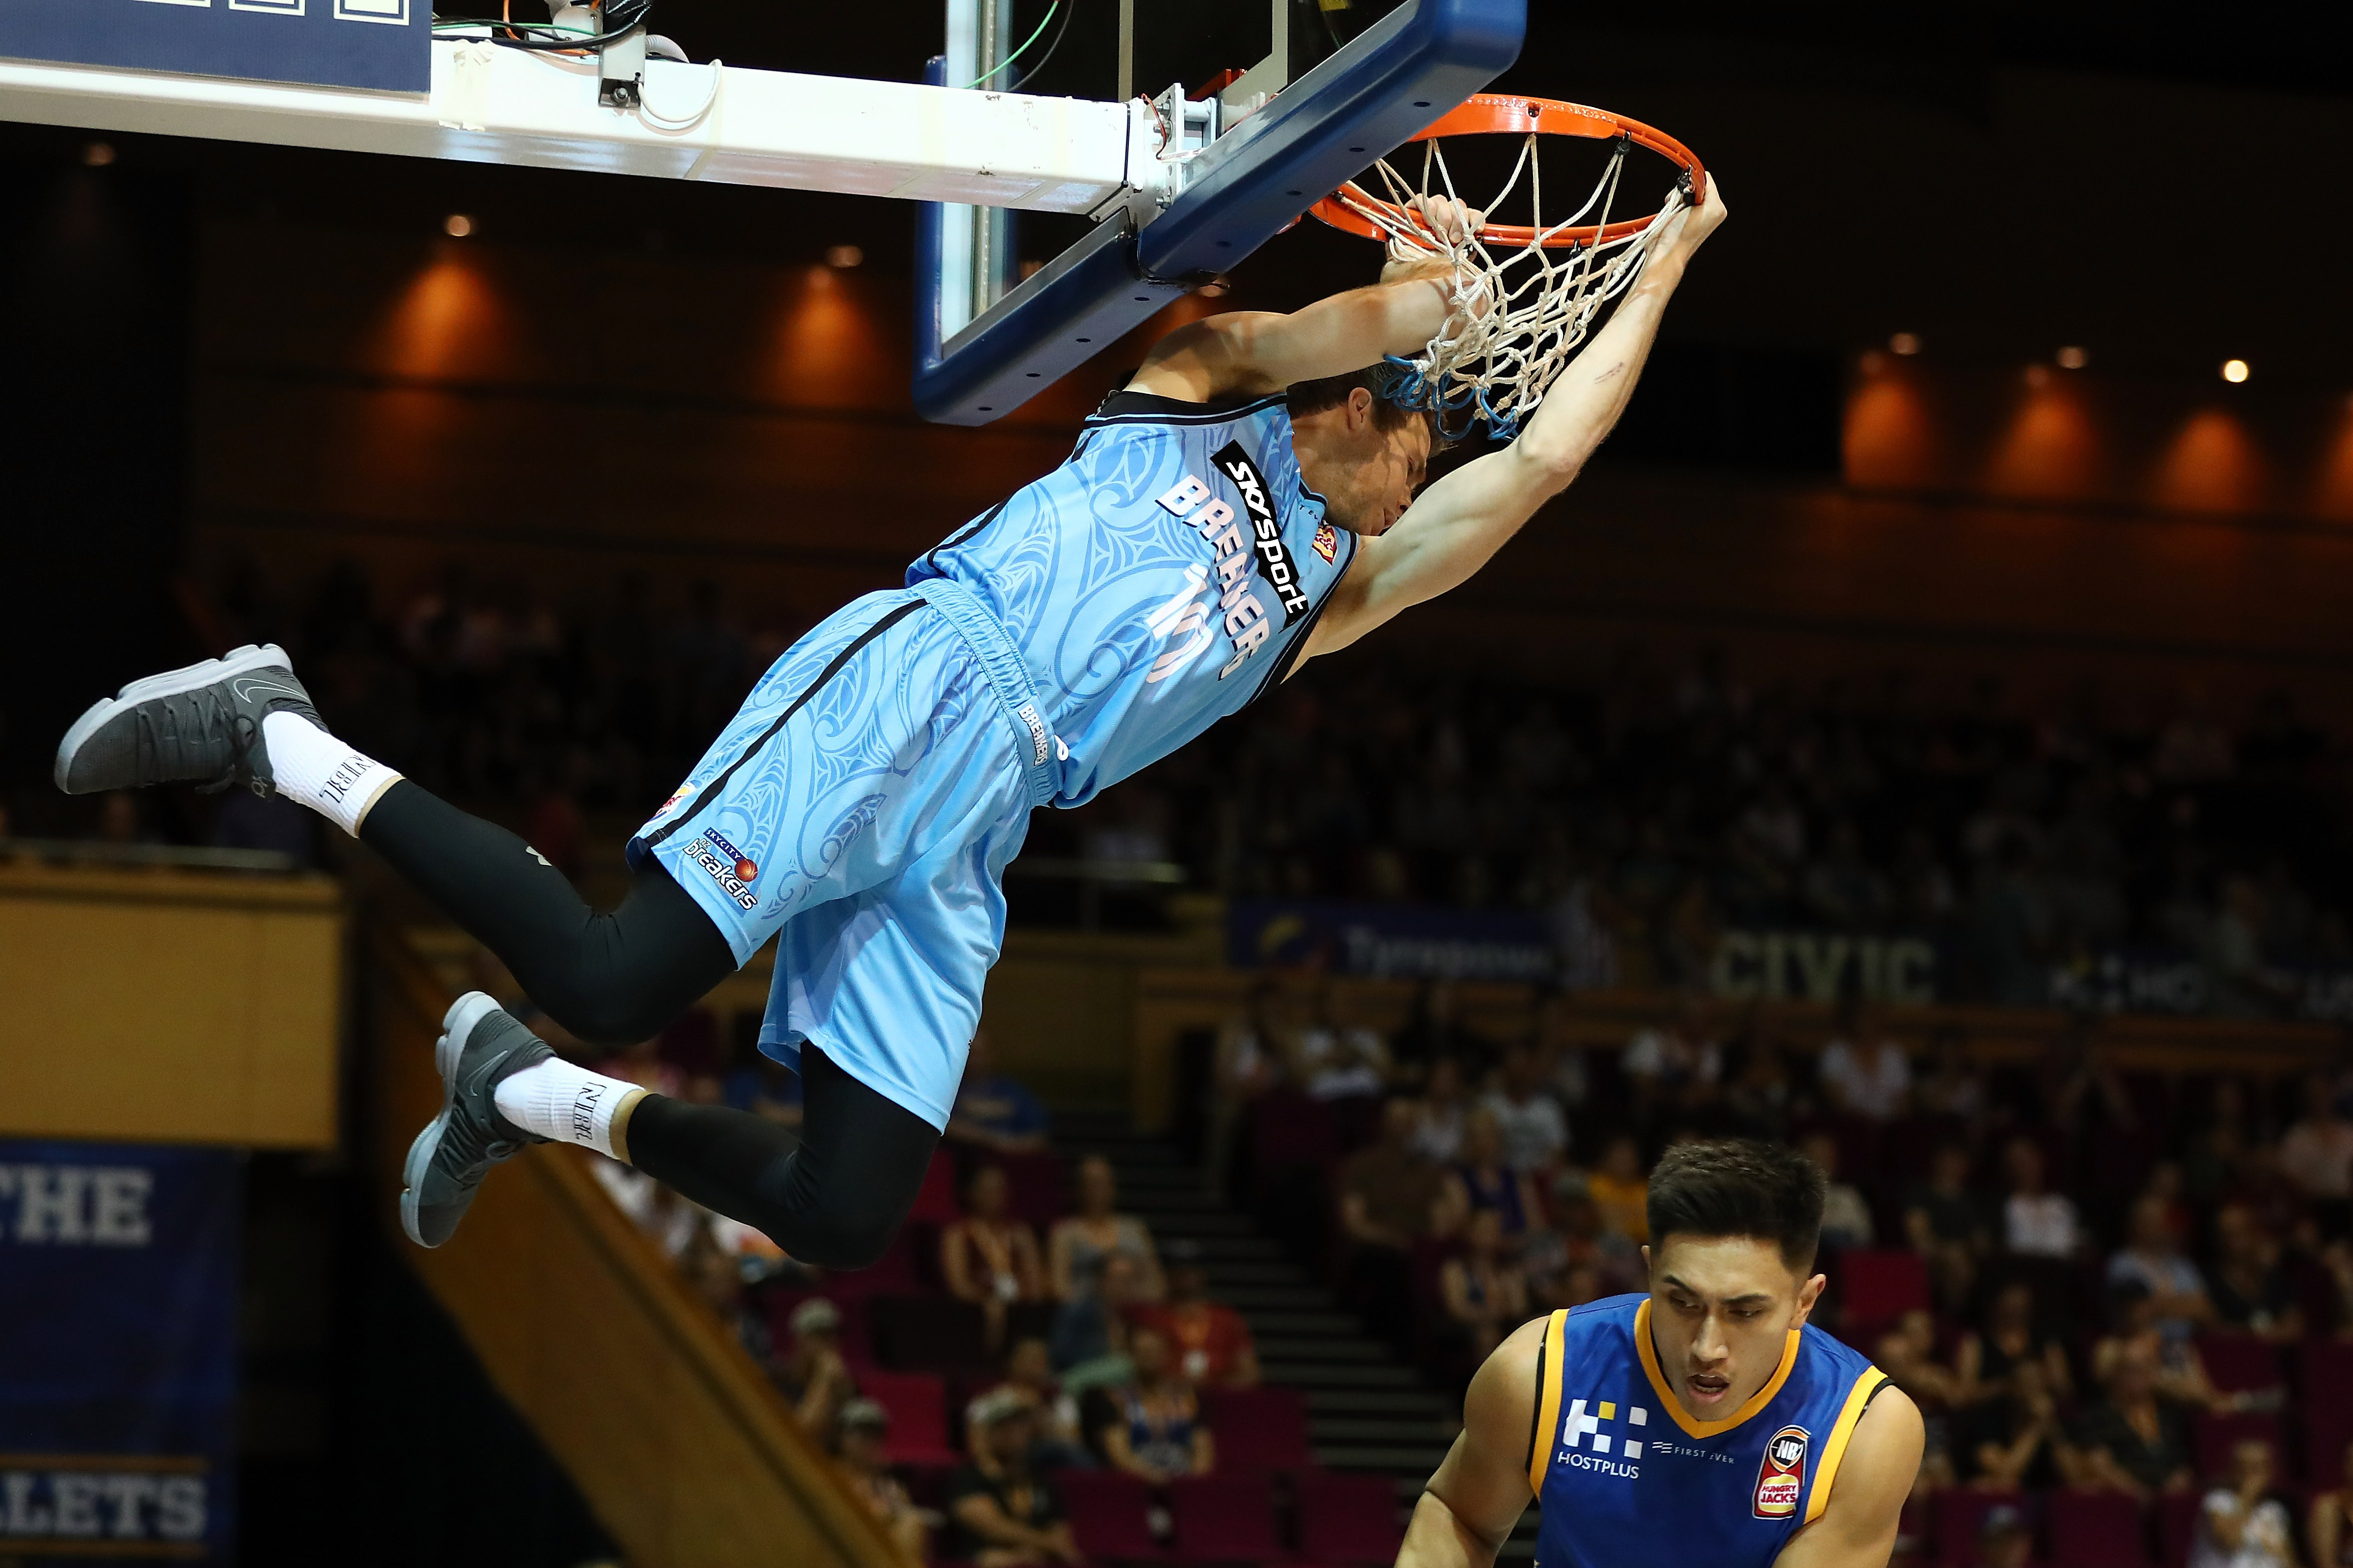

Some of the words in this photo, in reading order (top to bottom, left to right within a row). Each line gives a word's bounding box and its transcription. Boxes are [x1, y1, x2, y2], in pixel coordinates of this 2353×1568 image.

[1144, 563, 1214, 684] 10
[1018, 704, 1048, 766] BREAKERS
[683, 837, 758, 910] breakers
[699, 838, 712, 849] nz
[706, 829, 741, 859] SKYCITY
[1709, 930, 1936, 1000] CIVIC
[0, 1163, 153, 1247] HE
[1557, 1451, 1640, 1479] HOSTPLUS
[1674, 1446, 1706, 1457] FIRST
[0, 1472, 208, 1540] LETS
[1762, 1484, 1797, 1493] HUNGRY
